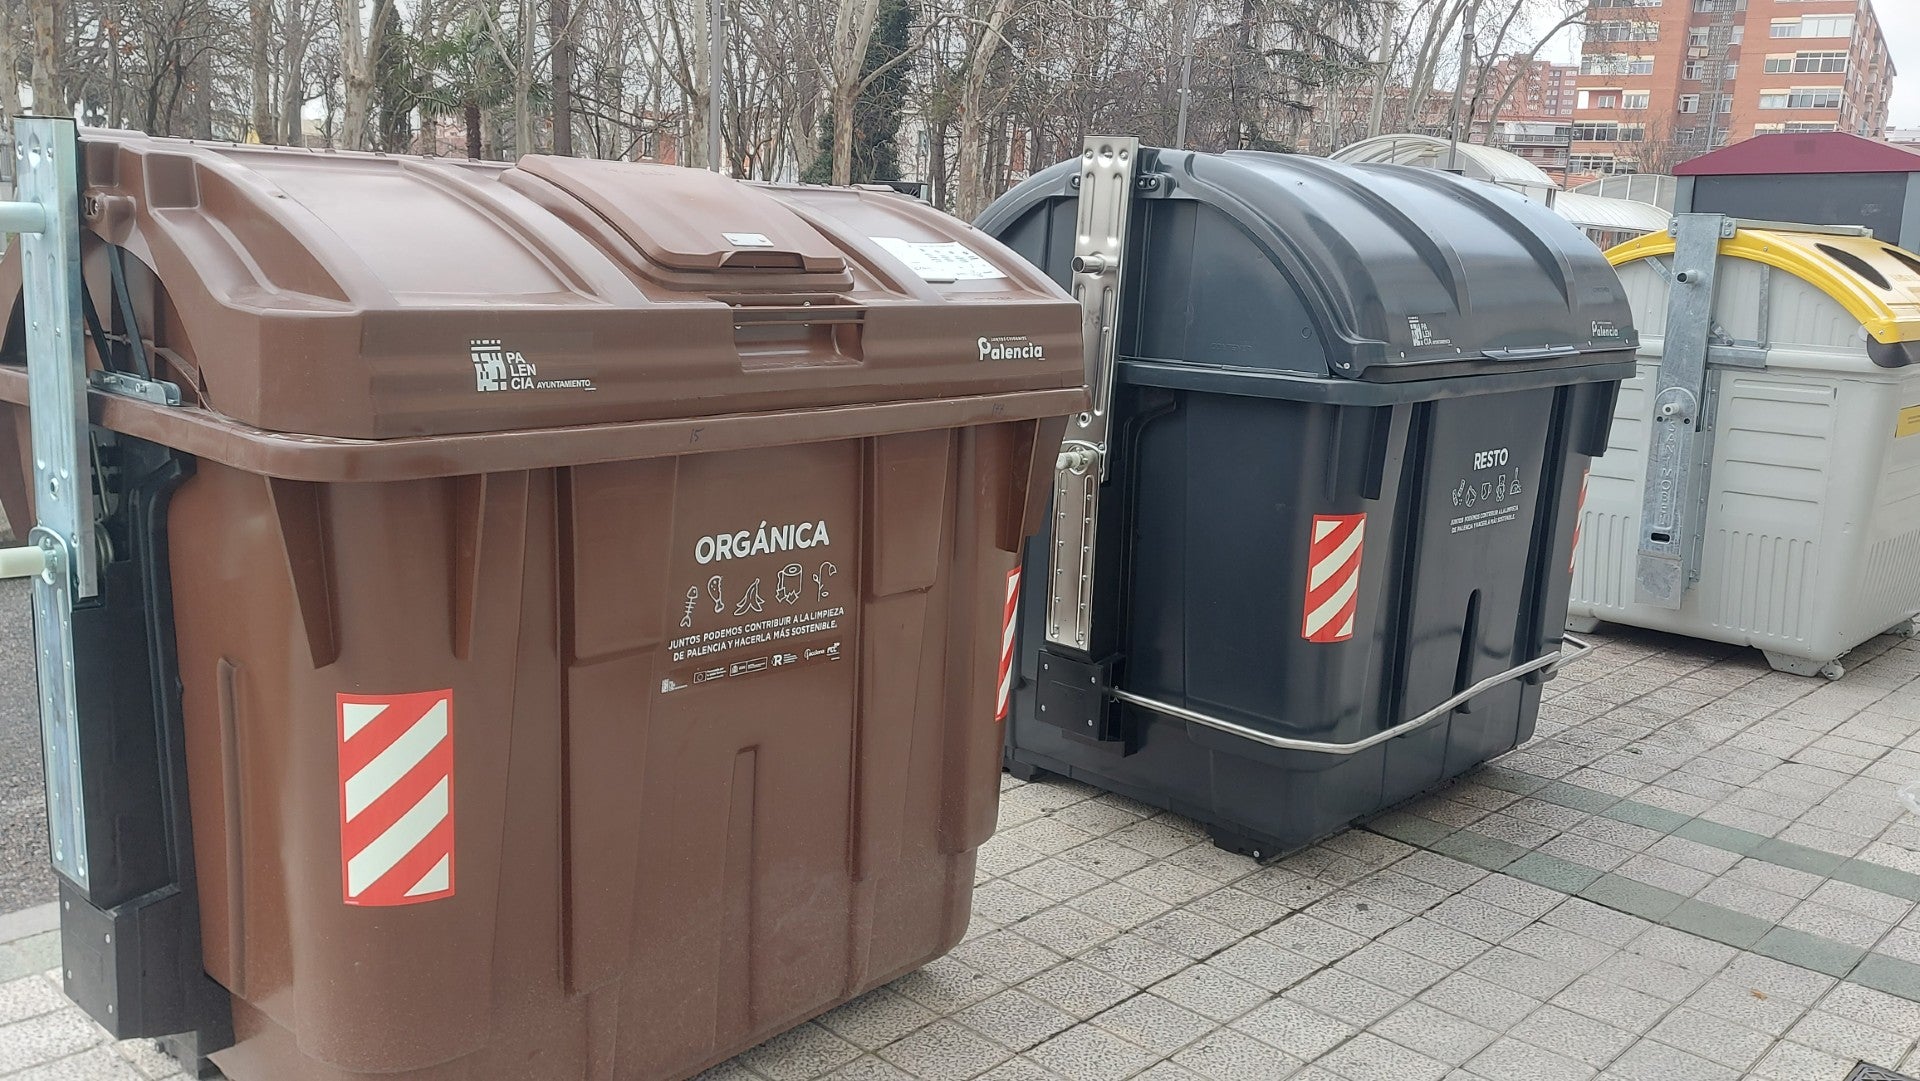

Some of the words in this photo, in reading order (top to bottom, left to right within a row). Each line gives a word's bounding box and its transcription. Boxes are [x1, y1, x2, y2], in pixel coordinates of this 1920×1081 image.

[1591, 320, 1619, 337] Palencia
[505, 352, 526, 364] PA
[977, 336, 1043, 361] Palencia
[509, 363, 537, 377] LEN
[510, 377, 535, 390] CIA
[536, 379, 592, 389] AYUNTAMIENTO
[1473, 447, 1509, 471] RESTO
[694, 520, 830, 565] ORGÁNICA
[667, 634, 701, 650] JUNTOS
[703, 625, 743, 642] PODEMOS
[744, 615, 792, 633] CONTRIBUIR
[793, 614, 799, 624] A
[800, 612, 810, 623] LA
[810, 606, 844, 620] LIMPIEZA
[673, 650, 685, 662] DE
[686, 642, 727, 659] PALENCIA
[727, 640, 734, 649] Y
[734, 632, 772, 648] HACERLA
[773, 627, 790, 640] MÁS
[791, 619, 838, 636] SOSTENIBLE.
